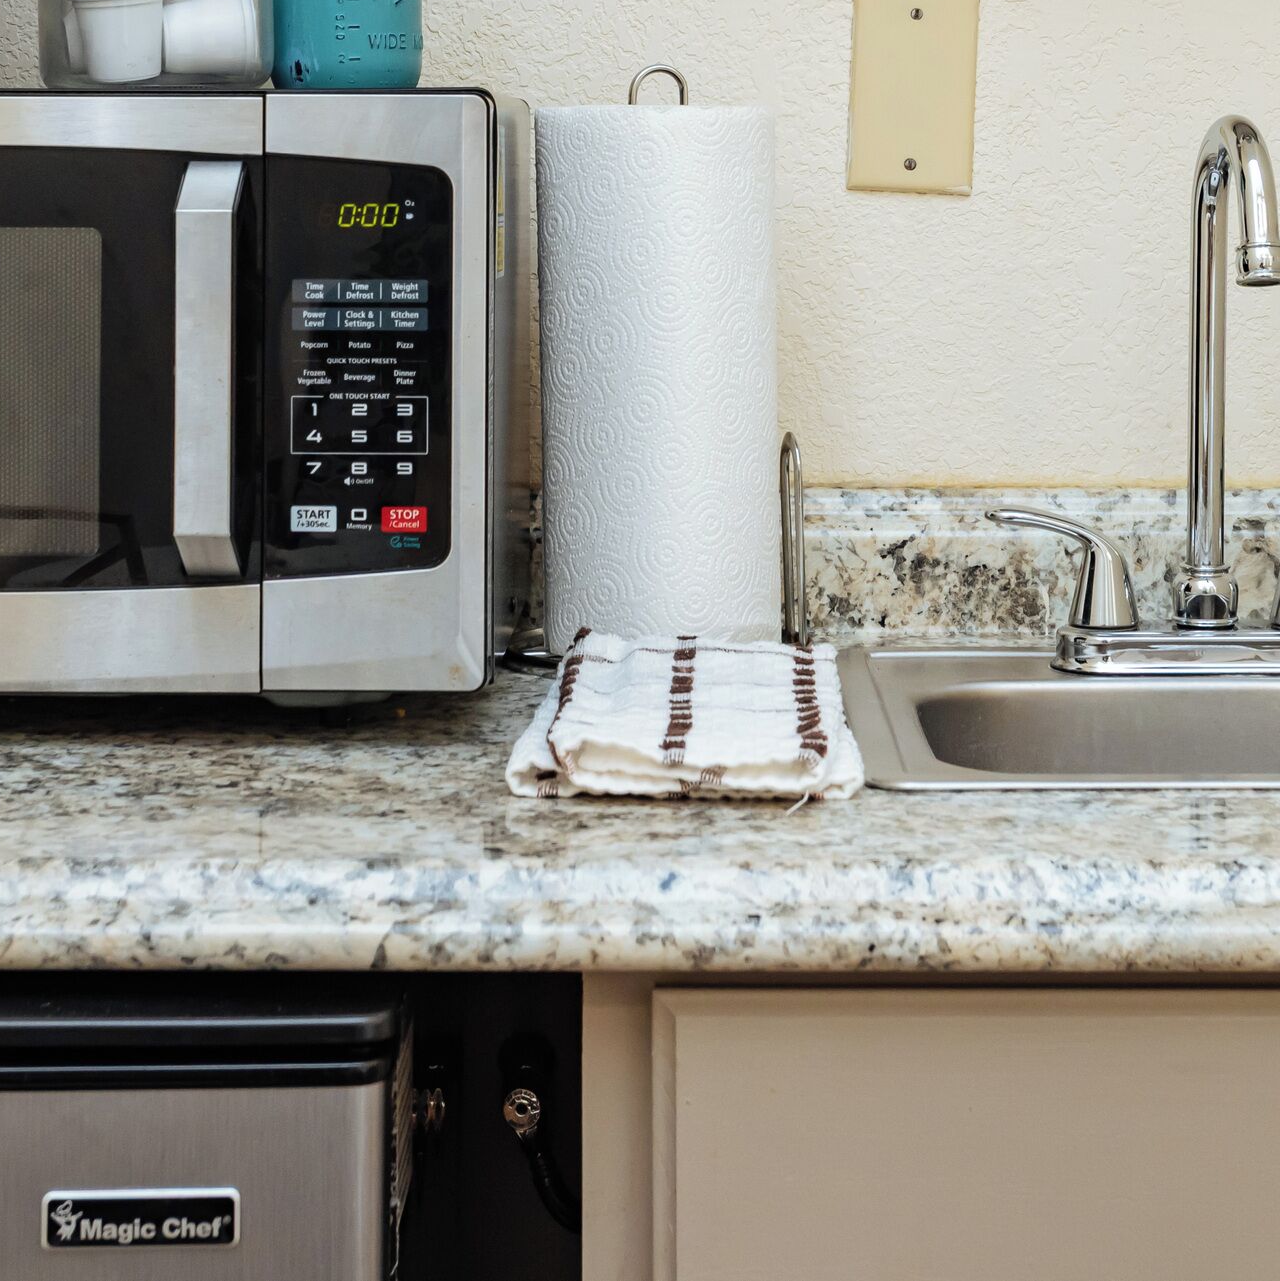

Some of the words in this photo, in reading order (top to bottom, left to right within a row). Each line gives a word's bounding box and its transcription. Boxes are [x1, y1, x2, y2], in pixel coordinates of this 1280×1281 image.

[368, 32, 407, 50] WIDE
[338, 203, 400, 228] 0:00
[305, 282, 324, 290] Time
[351, 282, 369, 290] Time
[391, 282, 419, 292] Weight
[305, 291, 324, 300] Cook
[346, 291, 374, 300] Defrost
[391, 291, 419, 300] Defrost
[302, 311, 326, 319] Power
[345, 311, 366, 319] Clock
[391, 311, 419, 319] Kitchen
[344, 320, 375, 329] Settings
[300, 341, 329, 350] Popcorn
[348, 341, 371, 349] Potato
[396, 341, 414, 349] Pizza
[303, 369, 326, 377] Frozen
[344, 373, 376, 382] Beverage
[393, 369, 416, 377] Dinner
[297, 377, 331, 386] Vegetable
[396, 377, 414, 385] Plate
[311, 402, 318, 417] 1
[351, 403, 368, 417] 2
[396, 403, 413, 417] 3
[306, 429, 323, 443] 4
[351, 429, 368, 443] 5
[396, 430, 413, 443] 6
[306, 461, 322, 475] 7
[351, 461, 368, 475] 8
[396, 462, 413, 475] 9
[296, 509, 331, 519] START
[389, 509, 420, 519] STOP
[346, 522, 372, 531] Memory
[80, 1217, 156, 1244] Magic
[162, 1216, 222, 1239] Chef
